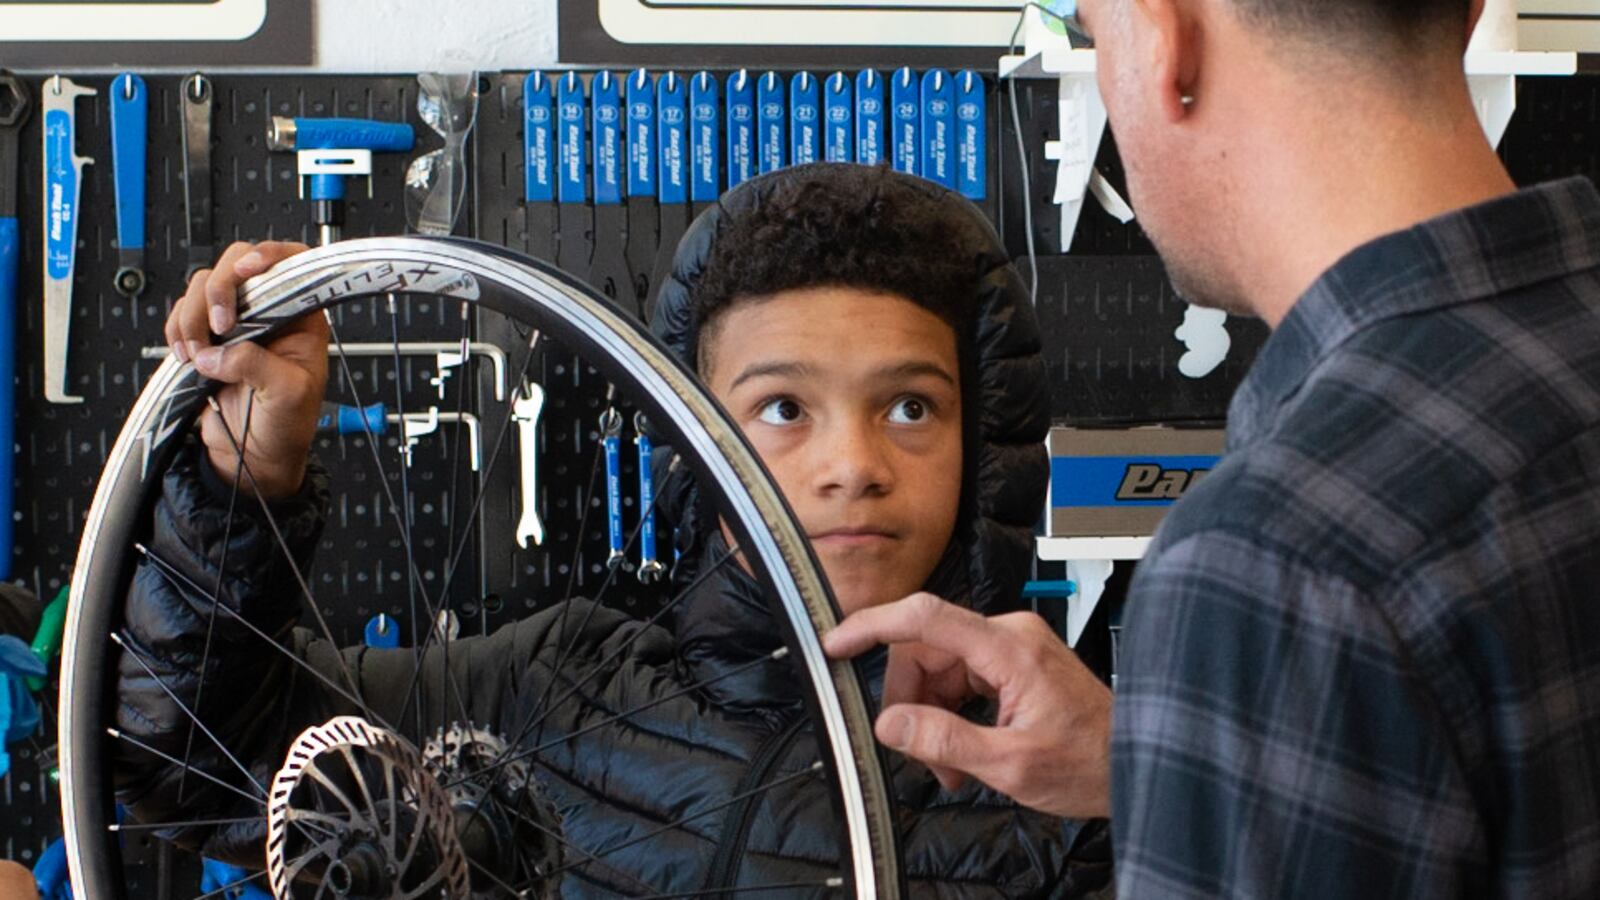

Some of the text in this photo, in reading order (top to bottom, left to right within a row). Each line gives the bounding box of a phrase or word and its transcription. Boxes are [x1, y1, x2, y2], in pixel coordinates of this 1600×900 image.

[537, 157, 547, 185] Tool
[570, 155, 580, 183] Tool
[606, 157, 616, 185] Tool
[639, 154, 649, 182] Tool
[671, 158, 681, 187] Tool
[703, 156, 713, 184] Tool
[936, 151, 946, 179] Tool
[967, 154, 977, 182] Tool
[52, 182, 63, 210] Tool
[51, 211, 62, 241] Park
[300, 262, 394, 309] ELITE
